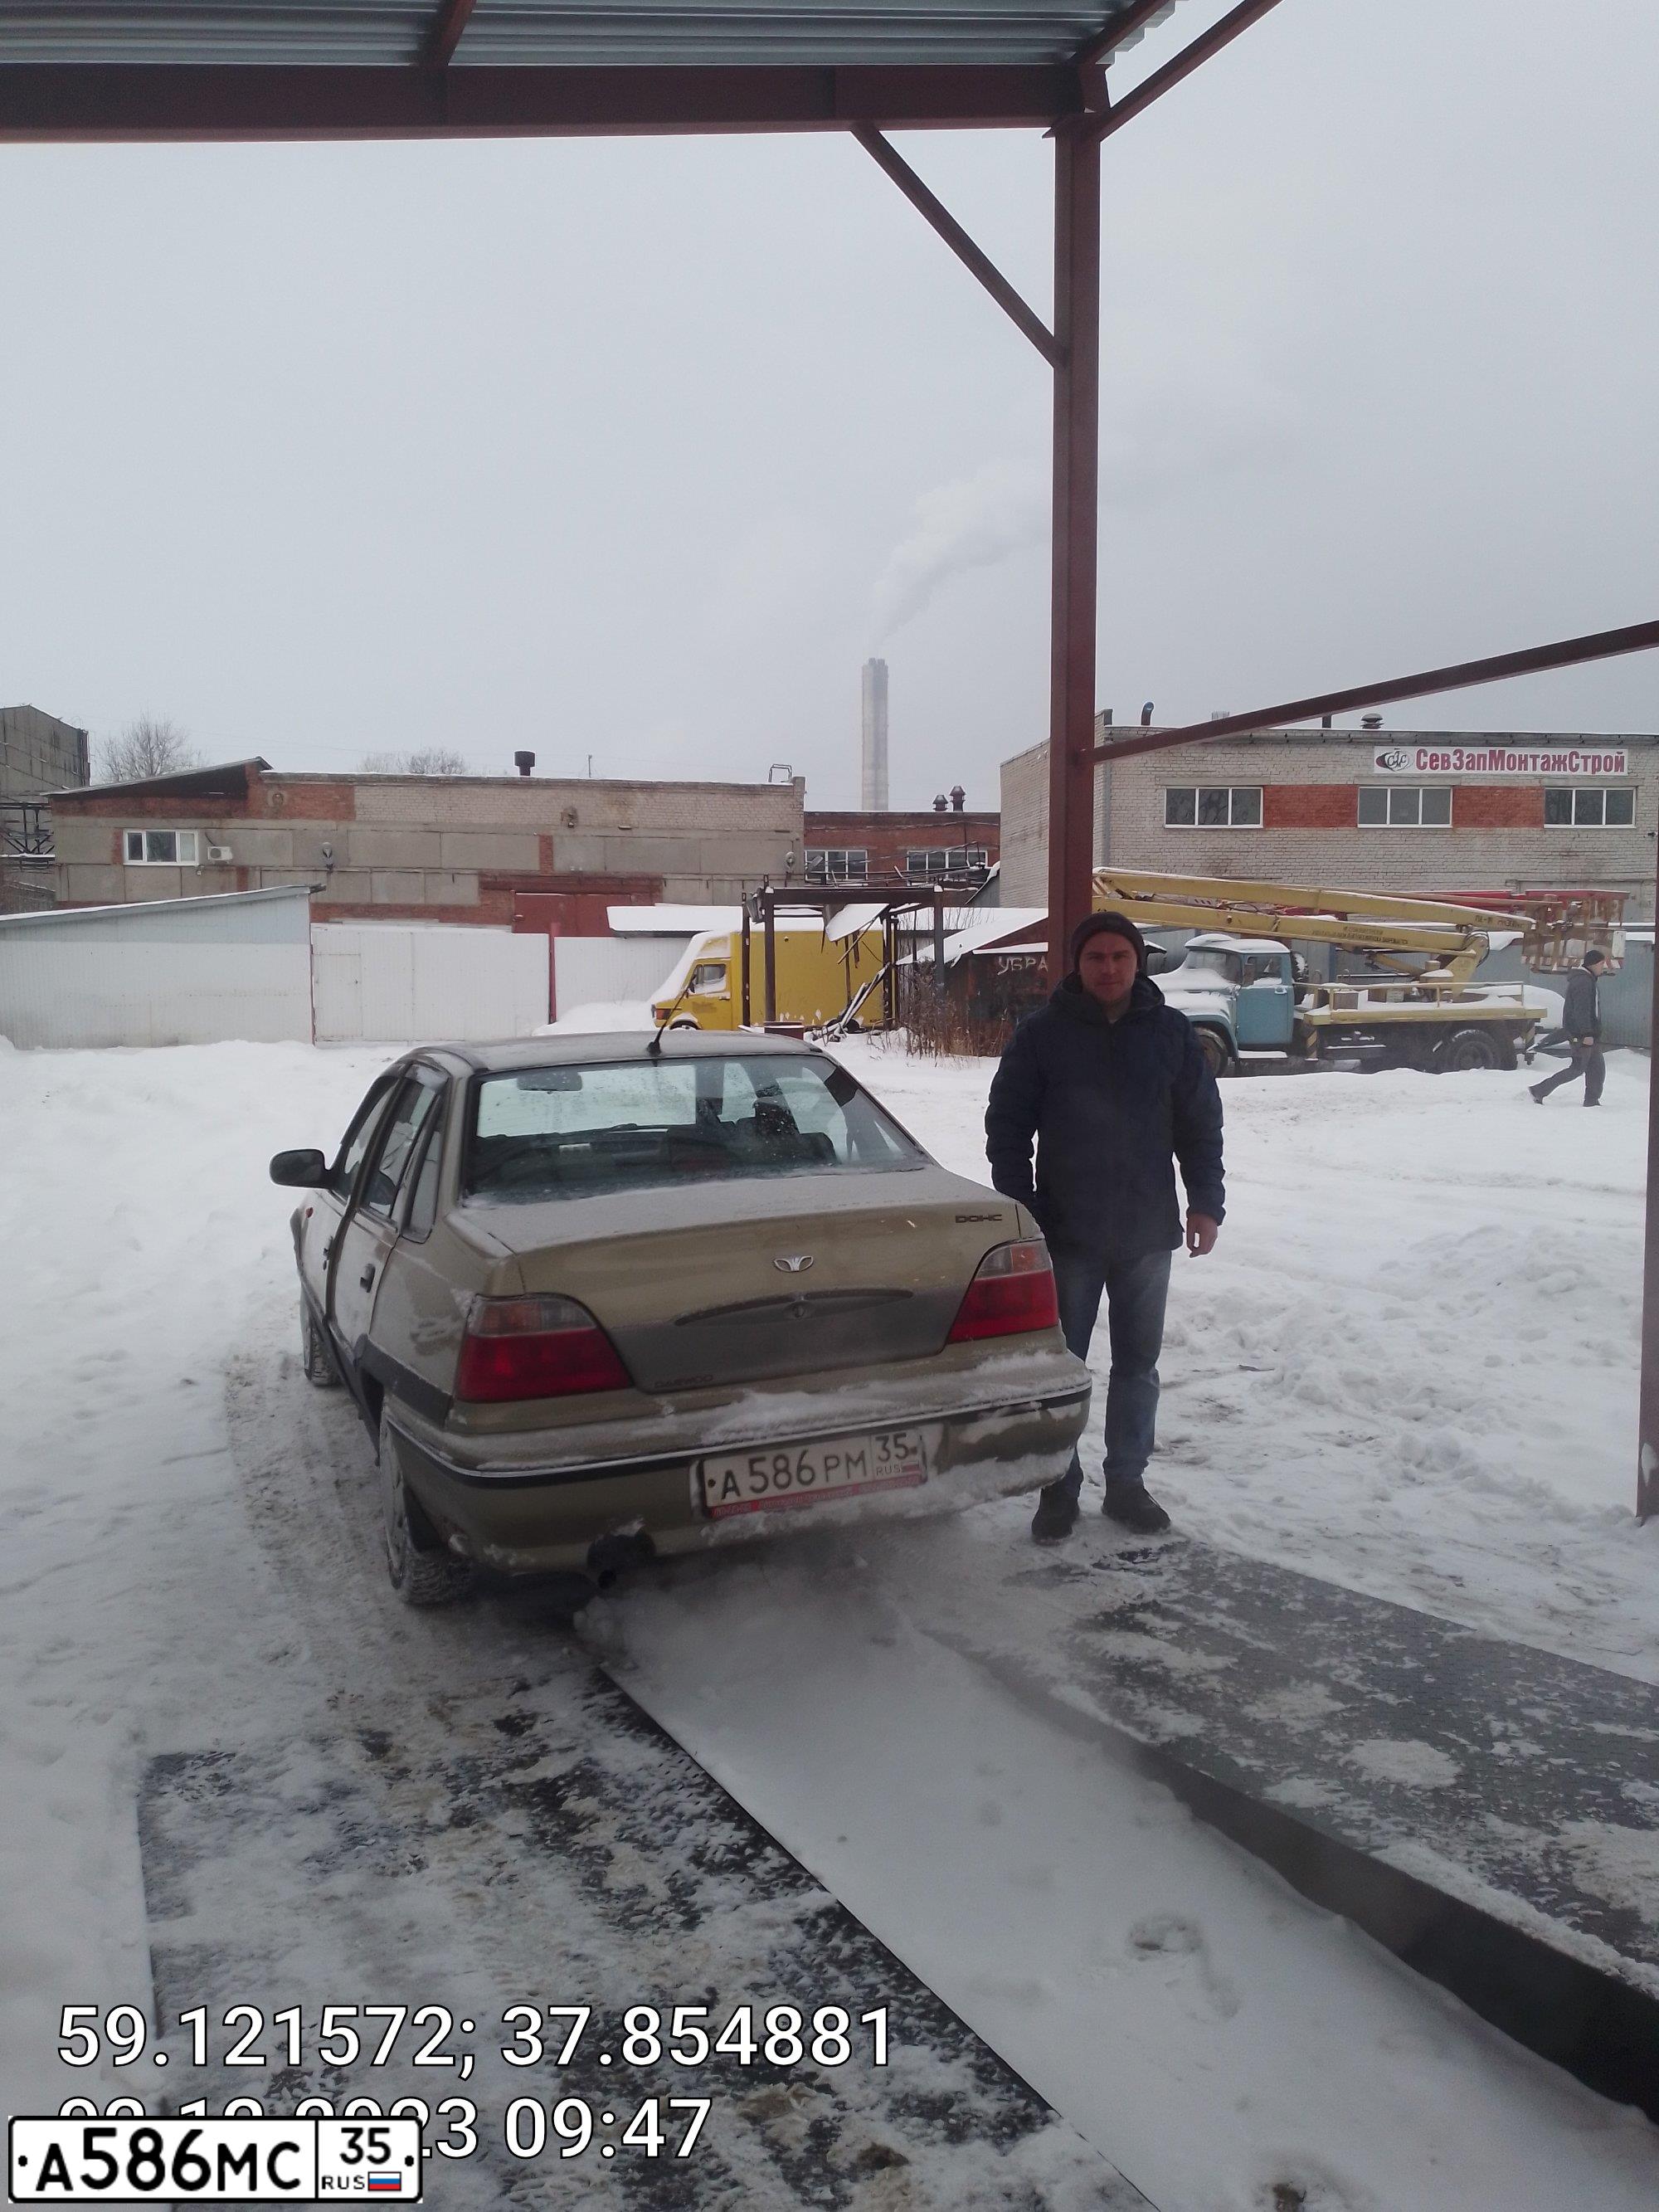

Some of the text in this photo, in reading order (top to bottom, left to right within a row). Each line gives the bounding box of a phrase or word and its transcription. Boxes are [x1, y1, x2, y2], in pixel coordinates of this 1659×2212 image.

[1415, 748, 1625, 774] СевЗапМонтажСтрой
[955, 1214, 1003, 1224] DOHC
[875, 1432, 909, 1462] 35
[876, 1464, 902, 1476] RUS
